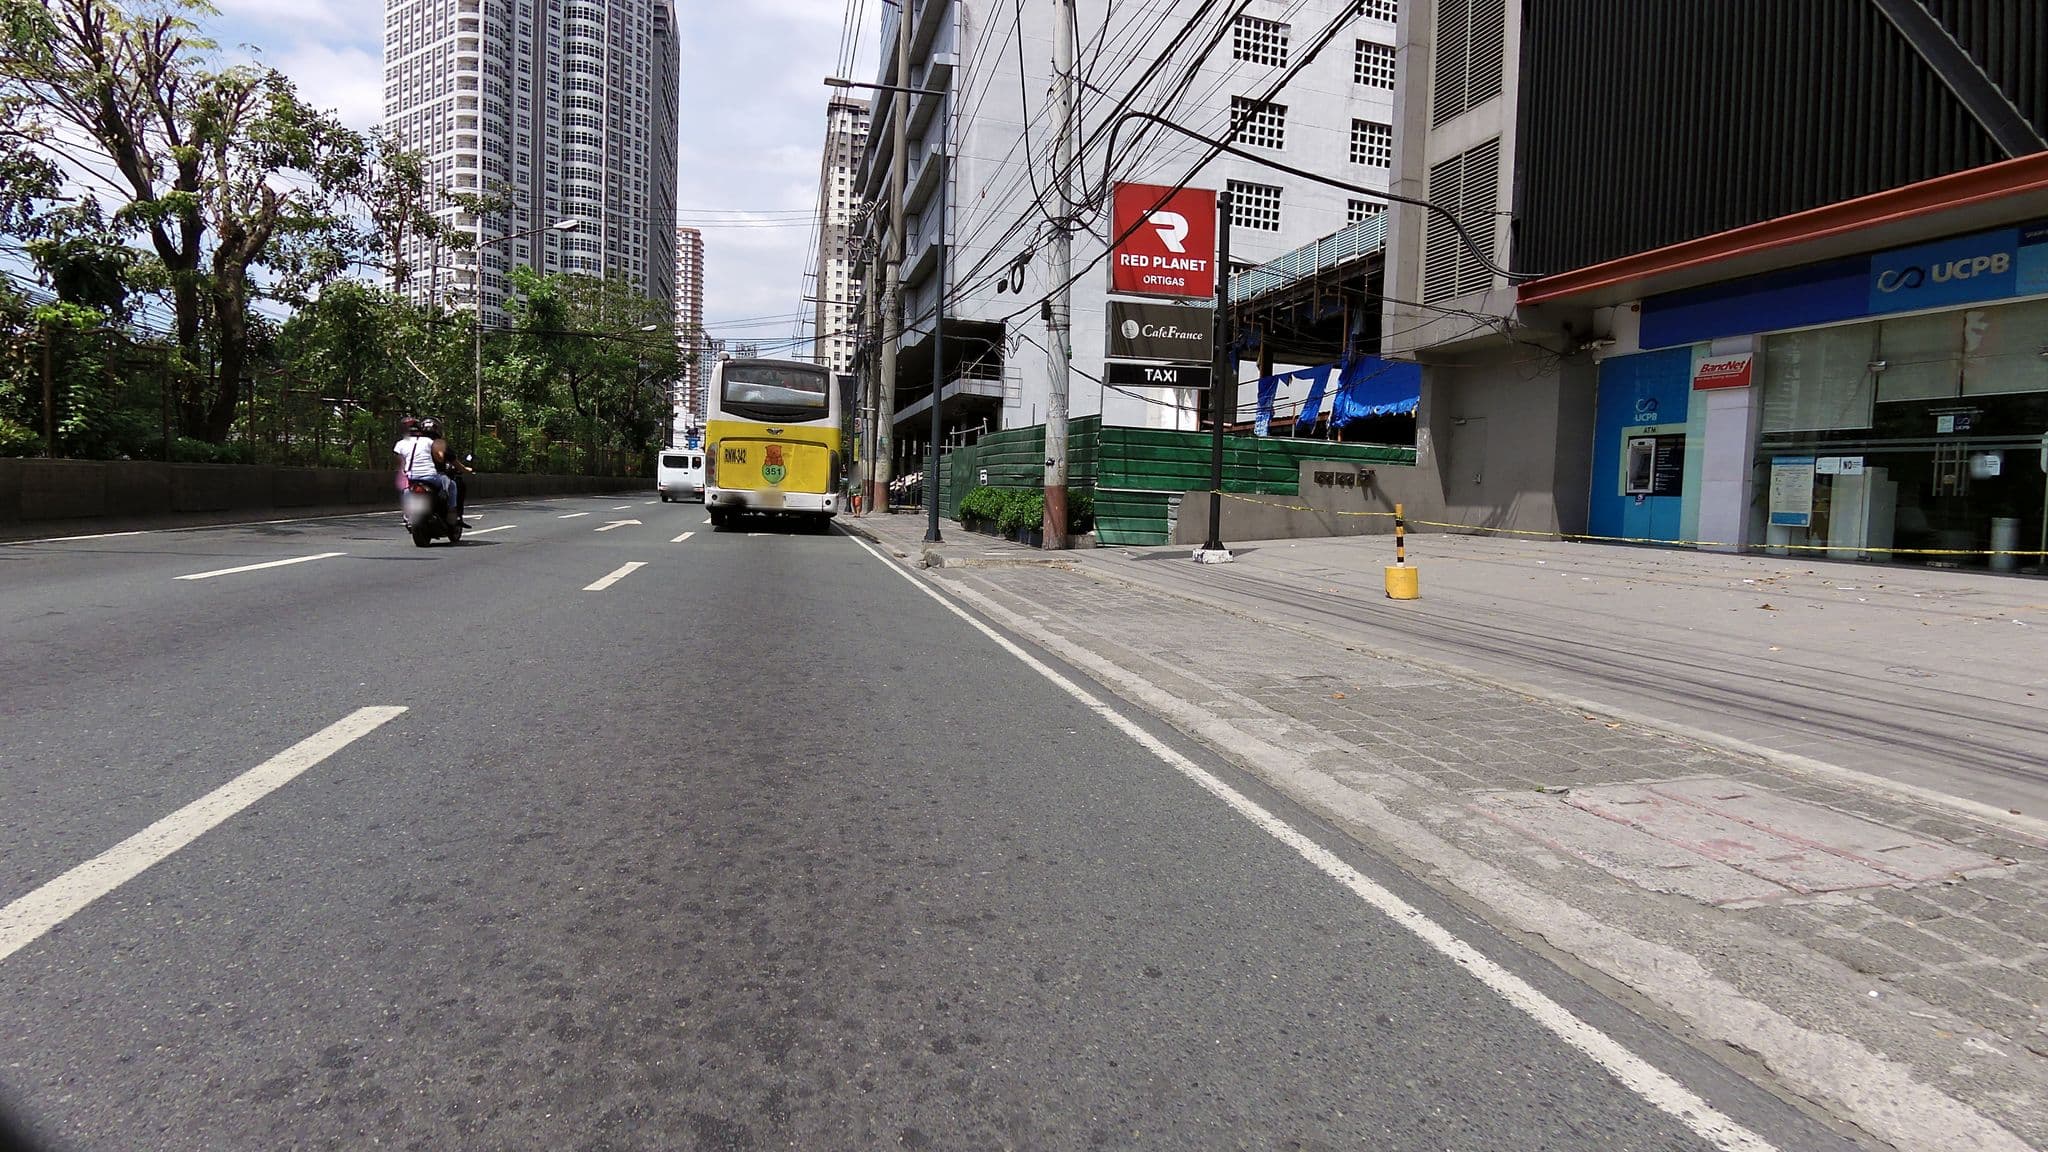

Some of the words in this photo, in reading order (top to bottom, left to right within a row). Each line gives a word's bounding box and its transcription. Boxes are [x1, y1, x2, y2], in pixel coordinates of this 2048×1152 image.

[1120, 253, 1149, 268] RED
[1152, 257, 1207, 272] PLANET
[1931, 252, 2010, 283] UCPB
[1143, 274, 1185, 286] ORTIGAS
[1700, 360, 1746, 373] BancNet
[1144, 368, 1177, 383] TAXI
[1635, 412, 1658, 422] UCPB
[1643, 426, 1656, 434] ATM
[765, 467, 781, 476] 351
